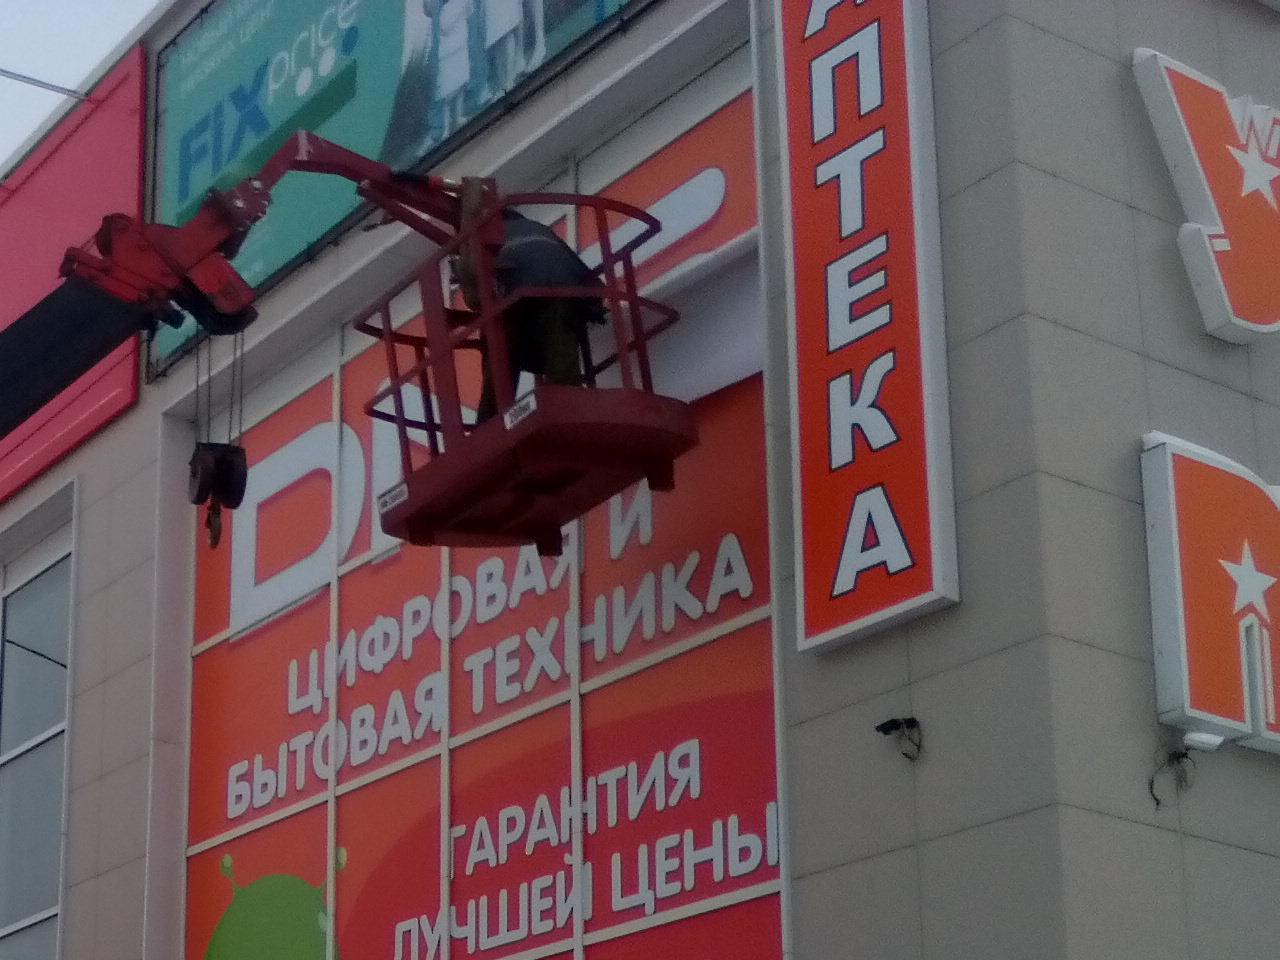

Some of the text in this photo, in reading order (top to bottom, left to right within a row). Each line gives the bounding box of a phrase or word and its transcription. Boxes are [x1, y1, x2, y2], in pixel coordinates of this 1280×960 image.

[609, 477, 652, 560] И
[227, 532, 753, 819] БЫТОВАЯ ТЕХНИКА
[449, 738, 700, 881] ГАРАНТИЯ
[611, 801, 780, 916] ЦЕНЫ
